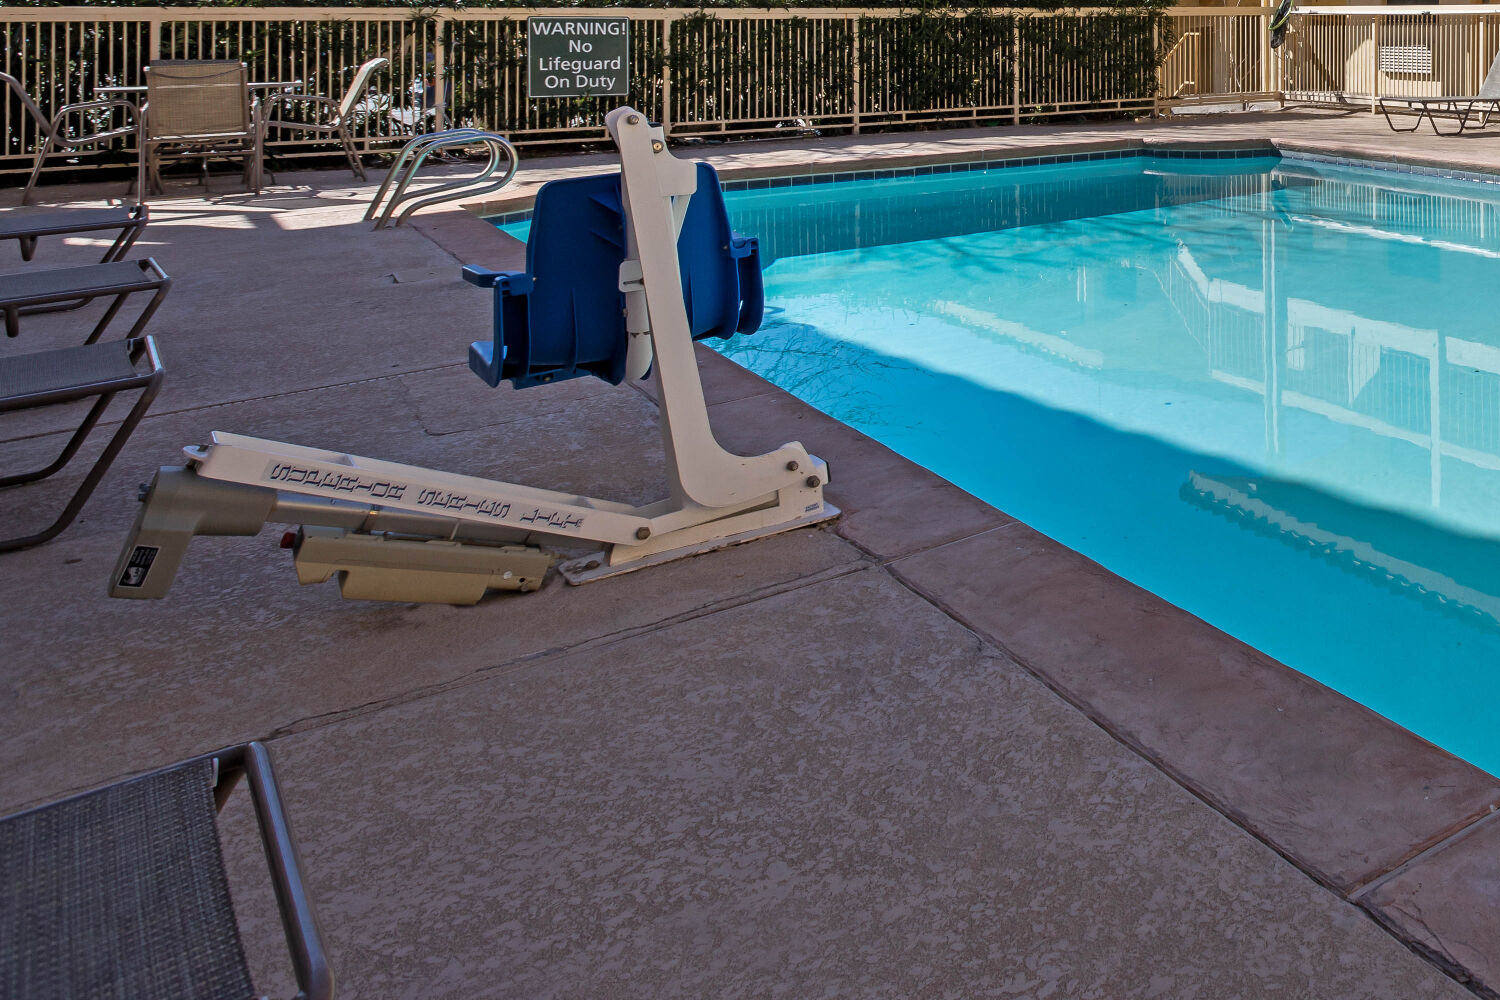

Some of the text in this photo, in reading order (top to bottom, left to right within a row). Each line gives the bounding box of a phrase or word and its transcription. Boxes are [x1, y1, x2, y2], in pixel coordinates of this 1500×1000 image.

[532, 22, 626, 36] WARNING!
[569, 40, 593, 53] No
[539, 56, 621, 74] Lifeguard
[545, 75, 616, 90] On Duty
[270, 463, 580, 529] SUPERIOR SERIES LIFT
